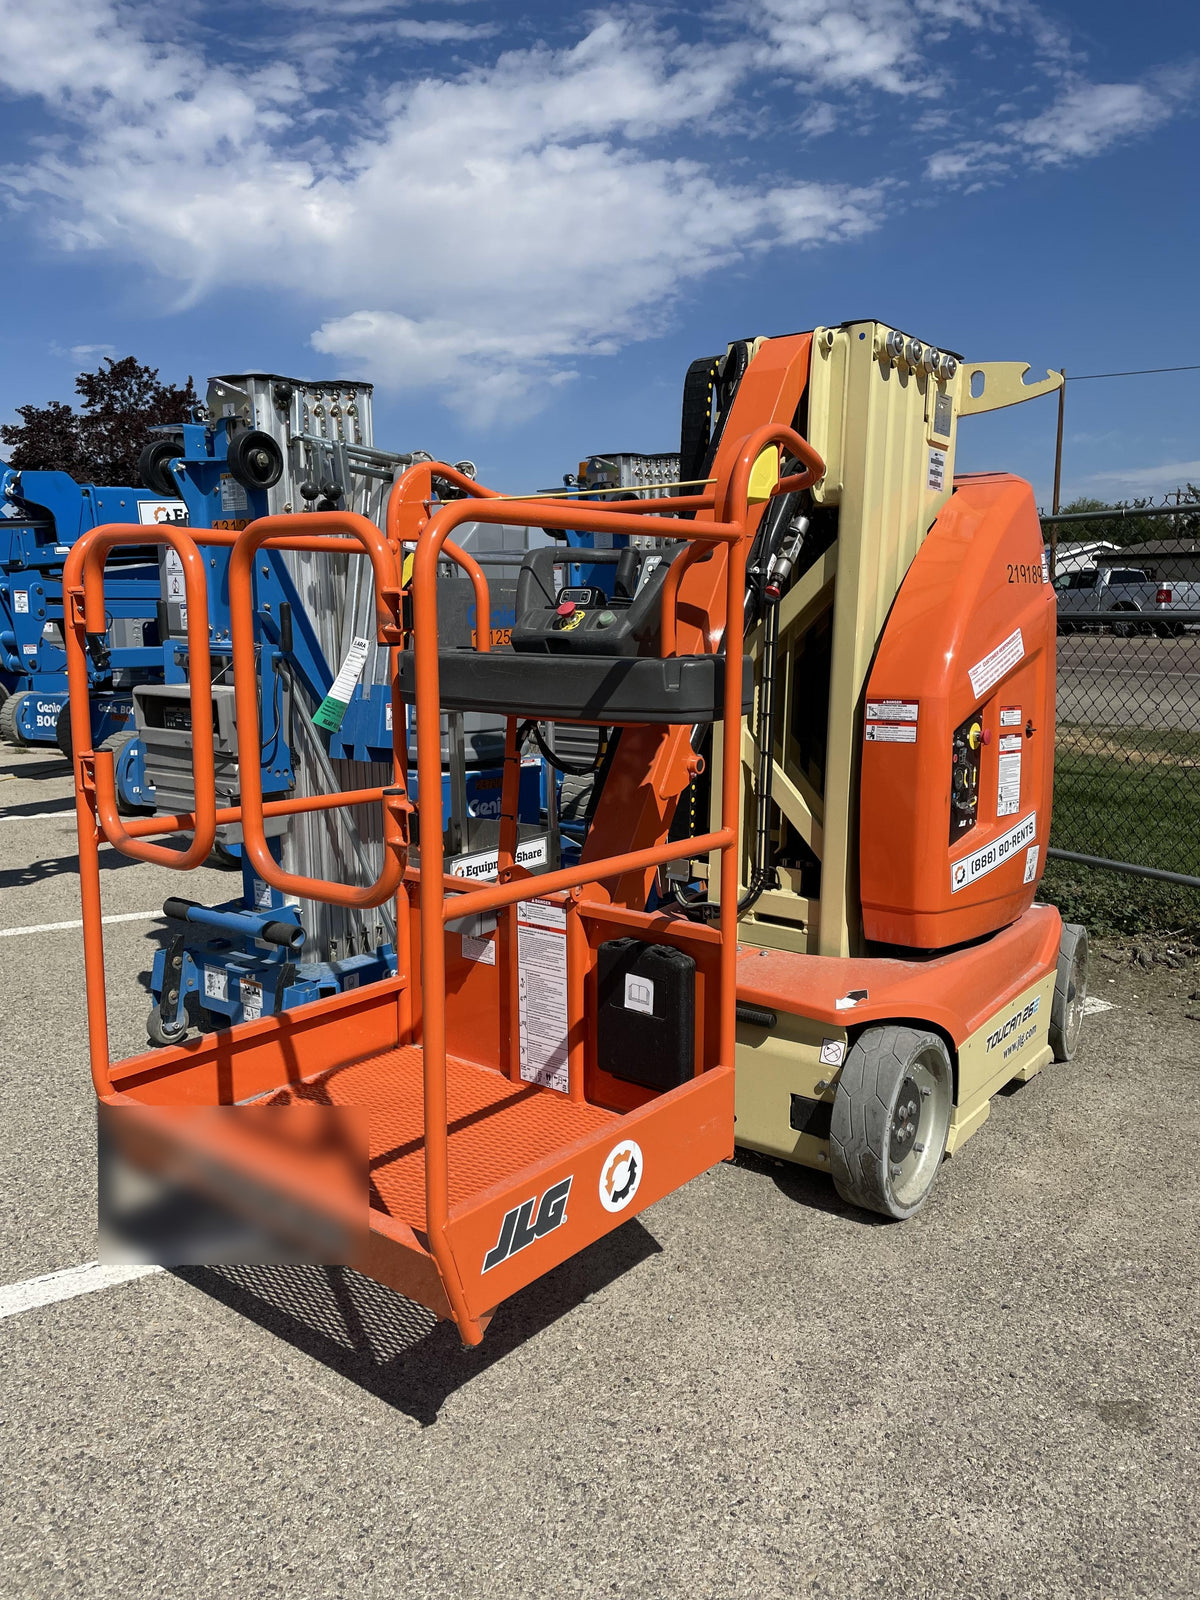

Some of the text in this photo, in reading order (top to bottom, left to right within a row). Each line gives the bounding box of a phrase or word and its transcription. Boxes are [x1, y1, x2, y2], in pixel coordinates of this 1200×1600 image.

[1007, 564, 1043, 584] 219189
[468, 797, 503, 817] Geni
[971, 822, 1034, 874] (888) 80-RENTS
[481, 1175, 574, 1275] JLG
